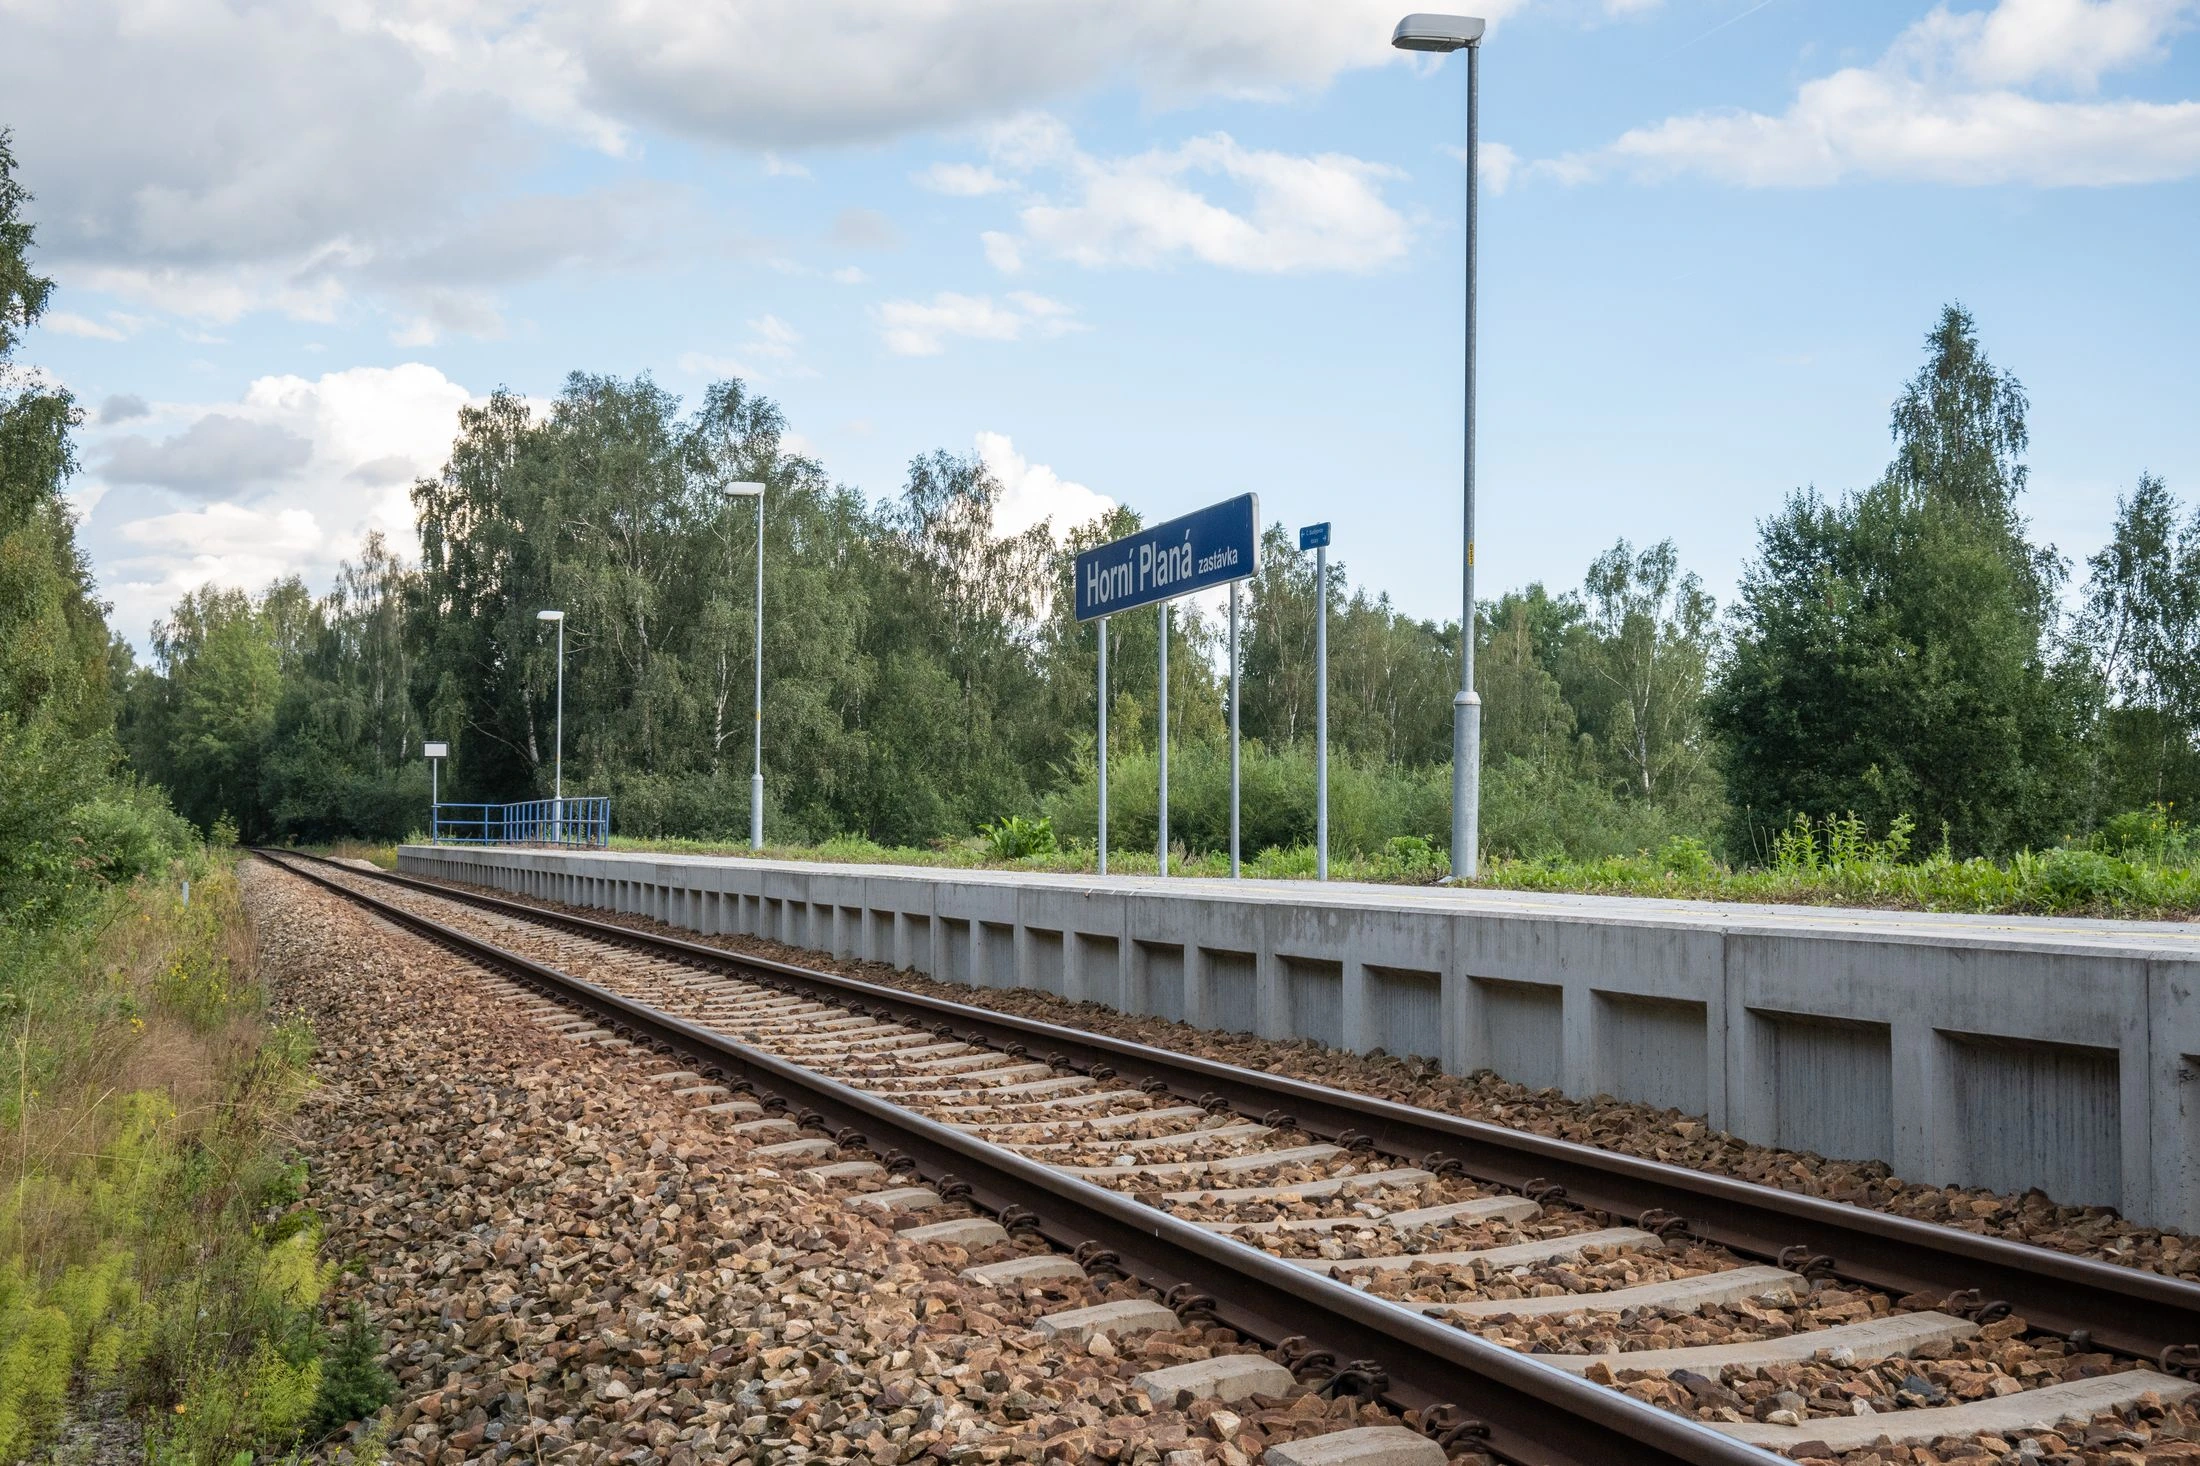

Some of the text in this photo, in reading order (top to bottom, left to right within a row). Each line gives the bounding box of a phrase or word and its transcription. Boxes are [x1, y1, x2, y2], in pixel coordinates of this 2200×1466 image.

[1087, 528, 1238, 607] Horní Planá zastávka
